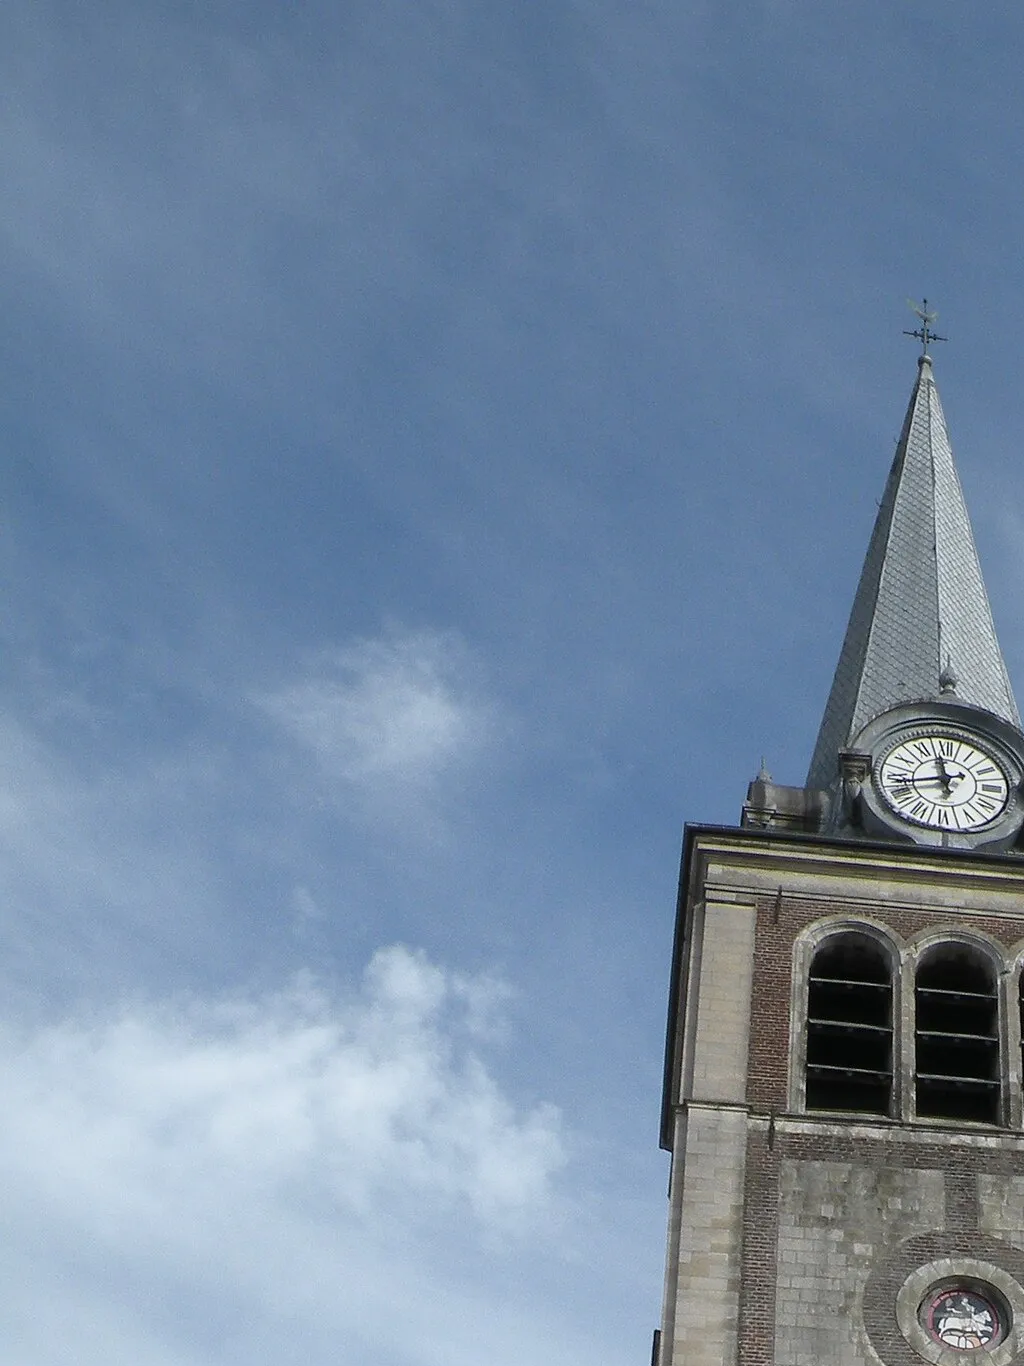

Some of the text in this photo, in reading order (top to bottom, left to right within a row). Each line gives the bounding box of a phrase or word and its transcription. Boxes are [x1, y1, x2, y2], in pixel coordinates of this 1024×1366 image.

[913, 741, 931, 758] XI
[938, 740, 954, 757] XII
[894, 753, 915, 767] X
[963, 751, 974, 762] I
[976, 766, 995, 775] II
[890, 787, 914, 804] VIII
[982, 784, 1002, 793] III
[910, 801, 929, 819] VII
[975, 798, 995, 813] IV
[938, 809, 949, 825] VI
[963, 809, 976, 823] V
